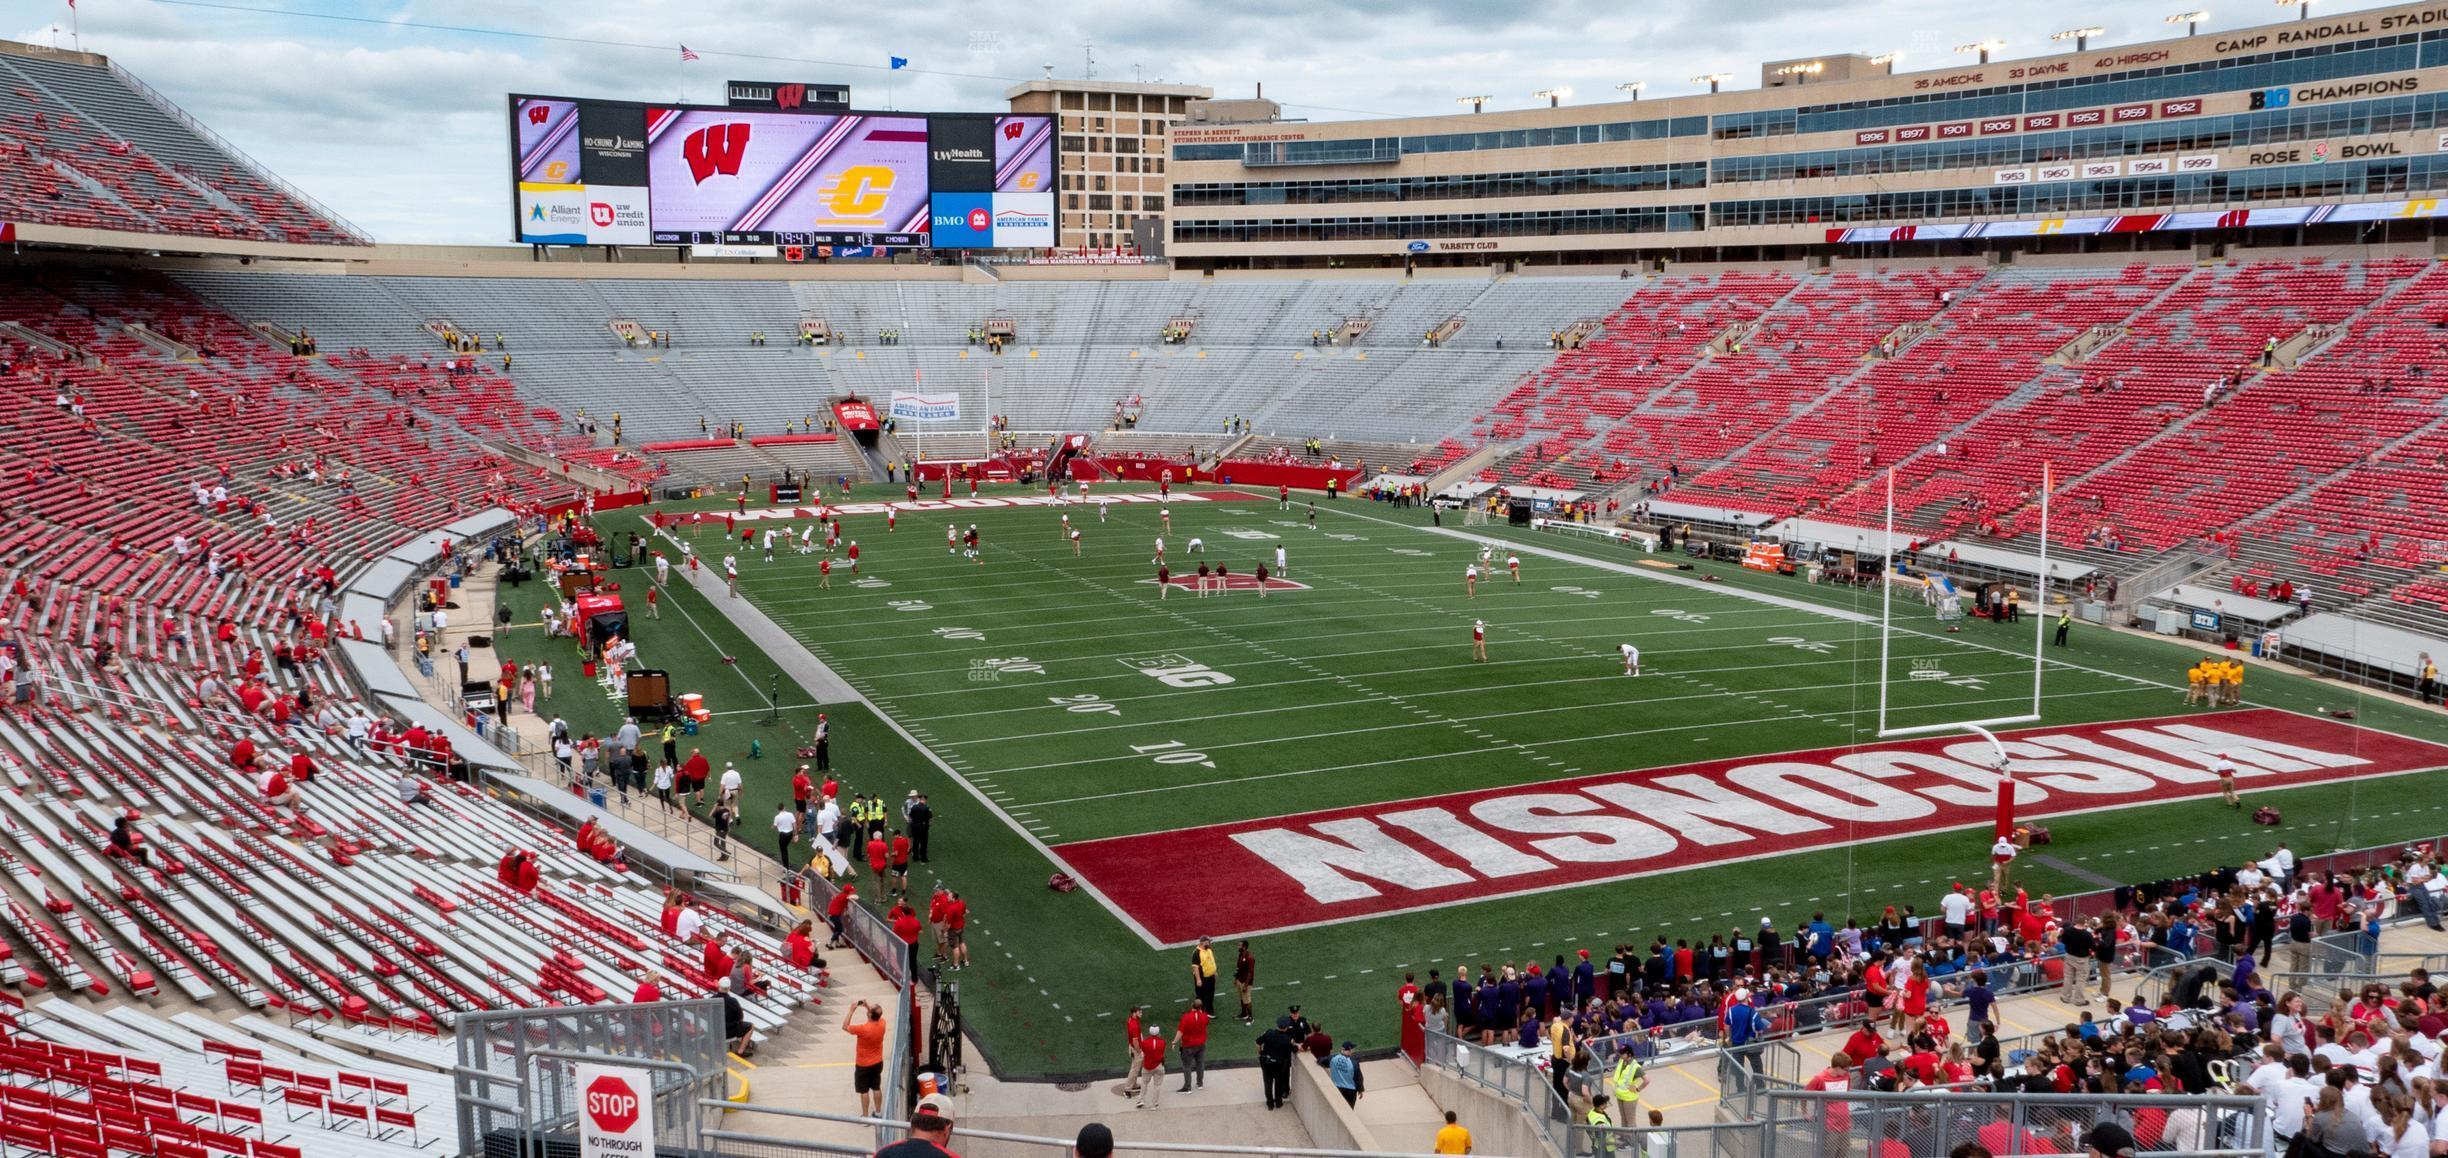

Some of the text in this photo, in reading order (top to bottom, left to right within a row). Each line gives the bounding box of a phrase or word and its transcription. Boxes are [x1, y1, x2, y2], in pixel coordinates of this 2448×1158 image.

[2215, 36, 2267, 53] CAMP
[2278, 21, 2370, 43] RANDALL
[2095, 50, 2169, 68] 40 HIRSCH
[2009, 62, 2069, 79] 33 DAYNE
[1914, 73, 1984, 89] 35 AMECHE
[2297, 77, 2418, 101] CHAMPIONS
[776, 84, 805, 110] W
[2118, 107, 2147, 118] 1959
[2165, 102, 2196, 113] 1962
[528, 106, 550, 125] W
[2072, 112, 2099, 123] 1952
[1983, 121, 2011, 131] 1906
[2029, 117, 2053, 128] 1912
[1004, 122, 1024, 141] W
[1900, 128, 1925, 139] 1897
[1943, 125, 1967, 135] 1901
[1859, 132, 1885, 143] 1896
[622, 140, 644, 149] GAMING
[684, 123, 750, 186] W
[2250, 143, 2401, 165] ROSE BOWL
[2134, 161, 2163, 172] 1994
[2183, 157, 2212, 168] 1999
[2042, 168, 2070, 178] 1960
[2087, 165, 2114, 175] 1963
[2000, 171, 2025, 181] 1953
[551, 205, 581, 215] Alliant
[616, 210, 644, 219] credit
[551, 215, 580, 225] Energy
[616, 219, 646, 227] union
[934, 217, 965, 226] BMO
[691, 231, 700, 244] 0
[920, 233, 926, 246] 0
[1440, 241, 1498, 250] VARSITY CLUB
[1048, 694, 1116, 713] 20
[1128, 740, 1208, 764] 10
[1228, 723, 2374, 905] WISCONSIN
[589, 1091, 636, 1117] STOP
[588, 1135, 643, 1151] NO THROUGH
